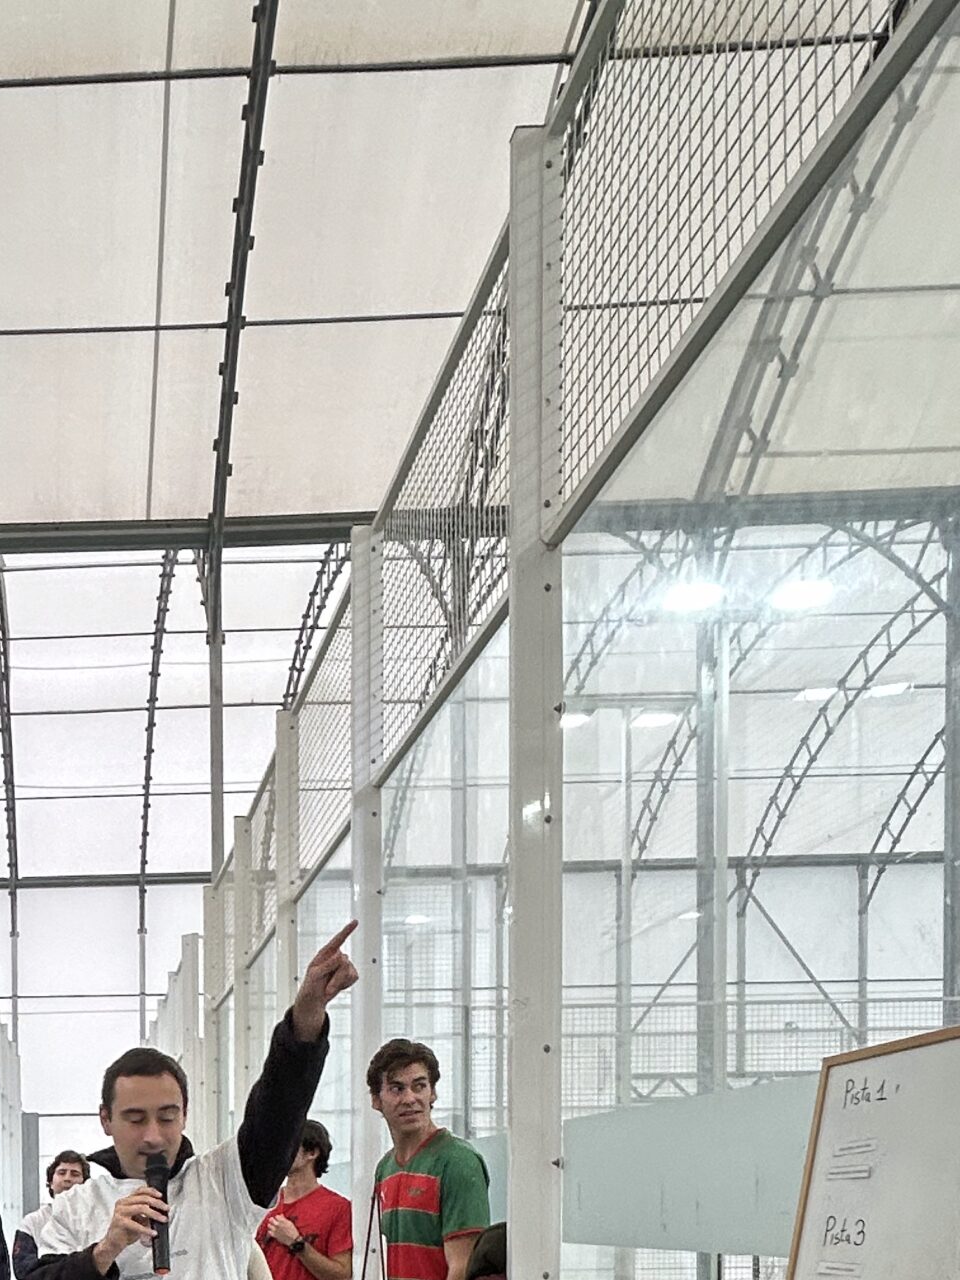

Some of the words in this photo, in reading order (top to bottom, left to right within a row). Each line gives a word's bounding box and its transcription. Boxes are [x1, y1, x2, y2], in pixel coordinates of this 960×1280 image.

[842, 1076, 871, 1109] Pista
[822, 1215, 851, 1247] Pista
[853, 1218, 866, 1246] 3
